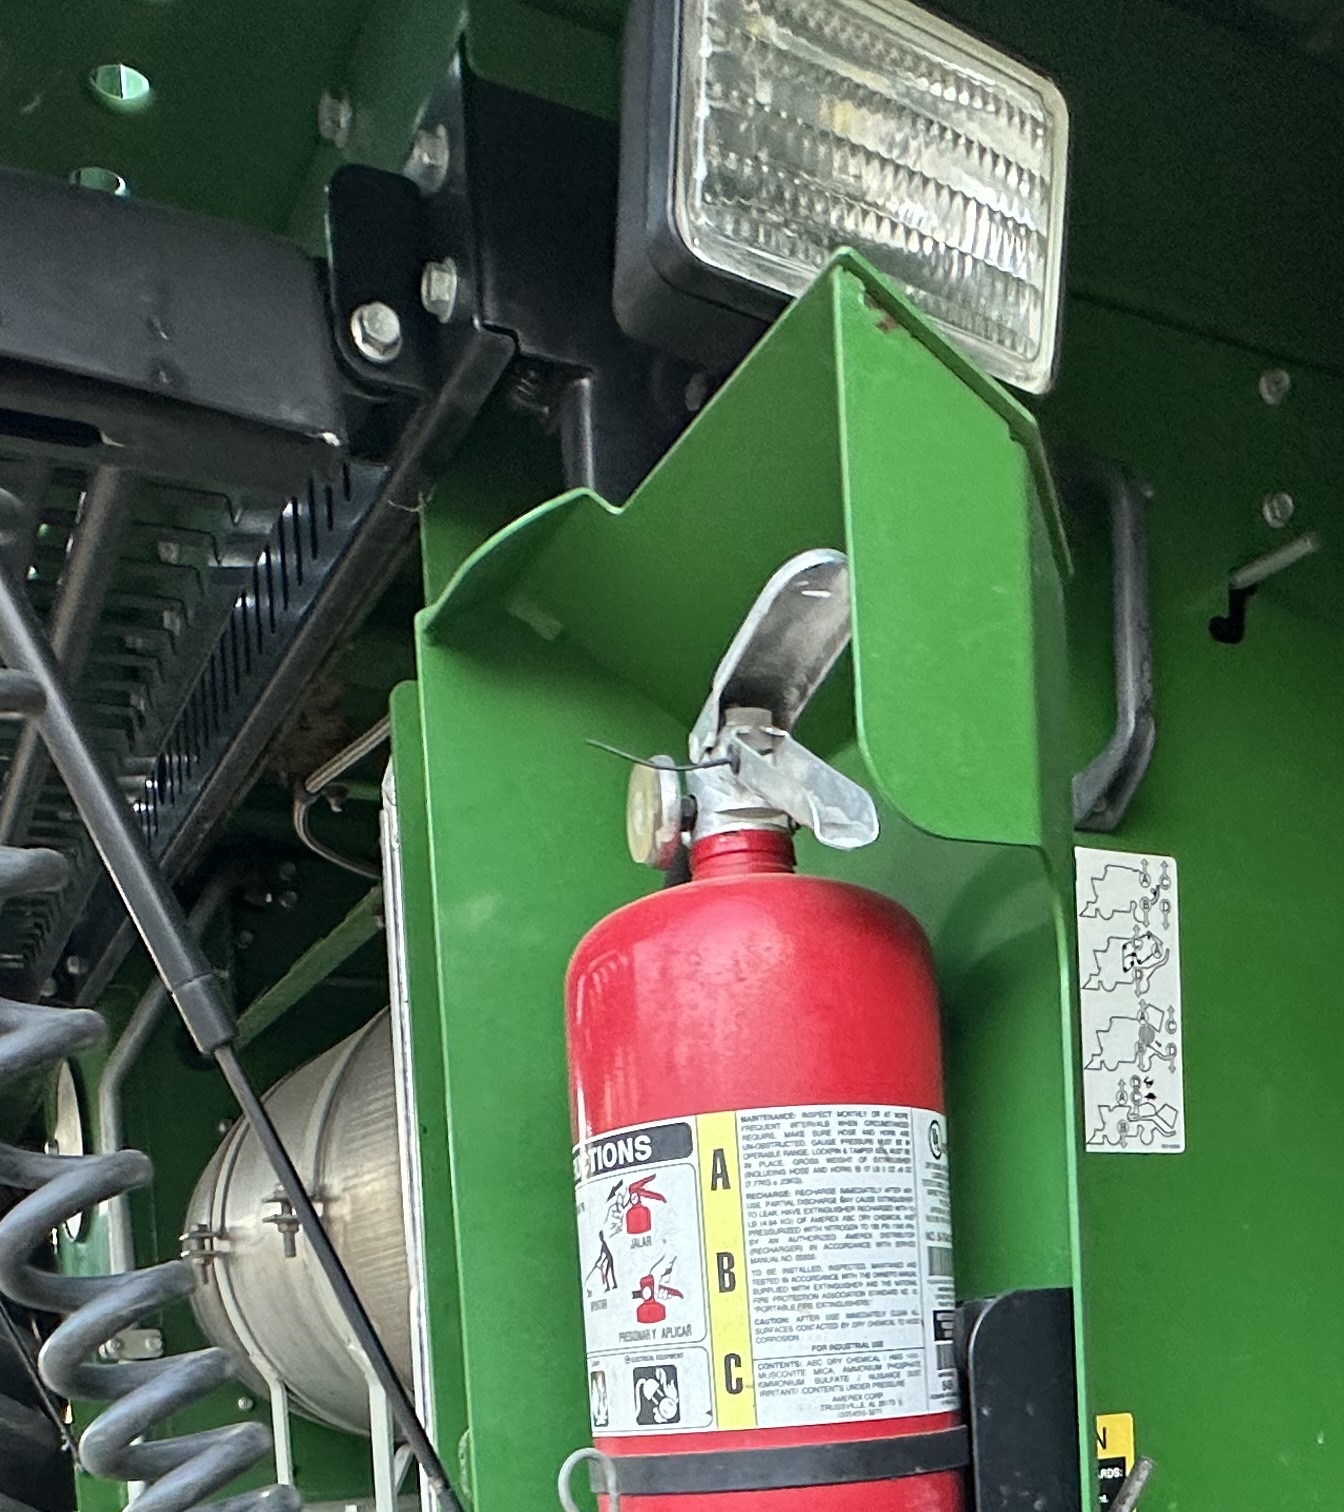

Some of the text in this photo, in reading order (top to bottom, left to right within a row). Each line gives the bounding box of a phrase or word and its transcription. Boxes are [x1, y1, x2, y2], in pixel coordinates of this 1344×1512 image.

[583, 1135, 653, 1175] TIONS
[711, 1148, 731, 1191] A
[716, 1251, 736, 1293] B
[724, 1353, 743, 1395] C
